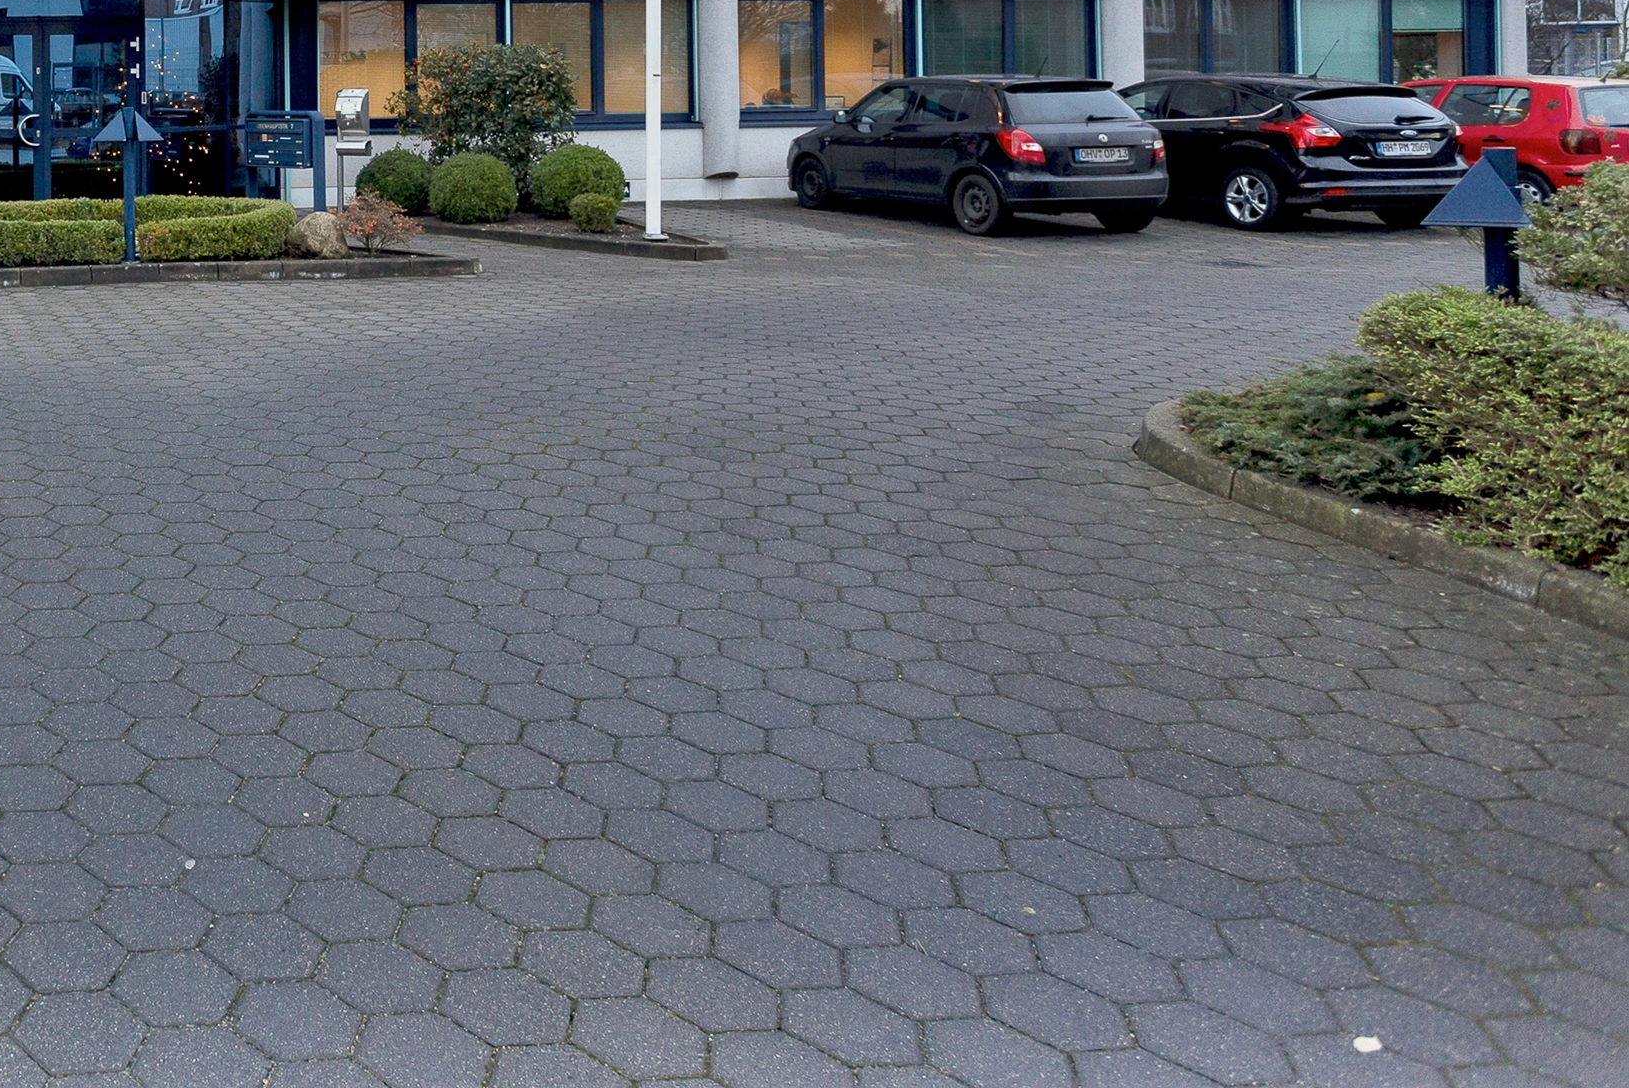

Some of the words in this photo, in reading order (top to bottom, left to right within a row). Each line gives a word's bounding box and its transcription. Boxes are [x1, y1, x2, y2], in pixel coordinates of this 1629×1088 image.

[1381, 142, 1394, 152] HH
[1080, 149, 1098, 159] OHV
[1118, 149, 1128, 159] 13
